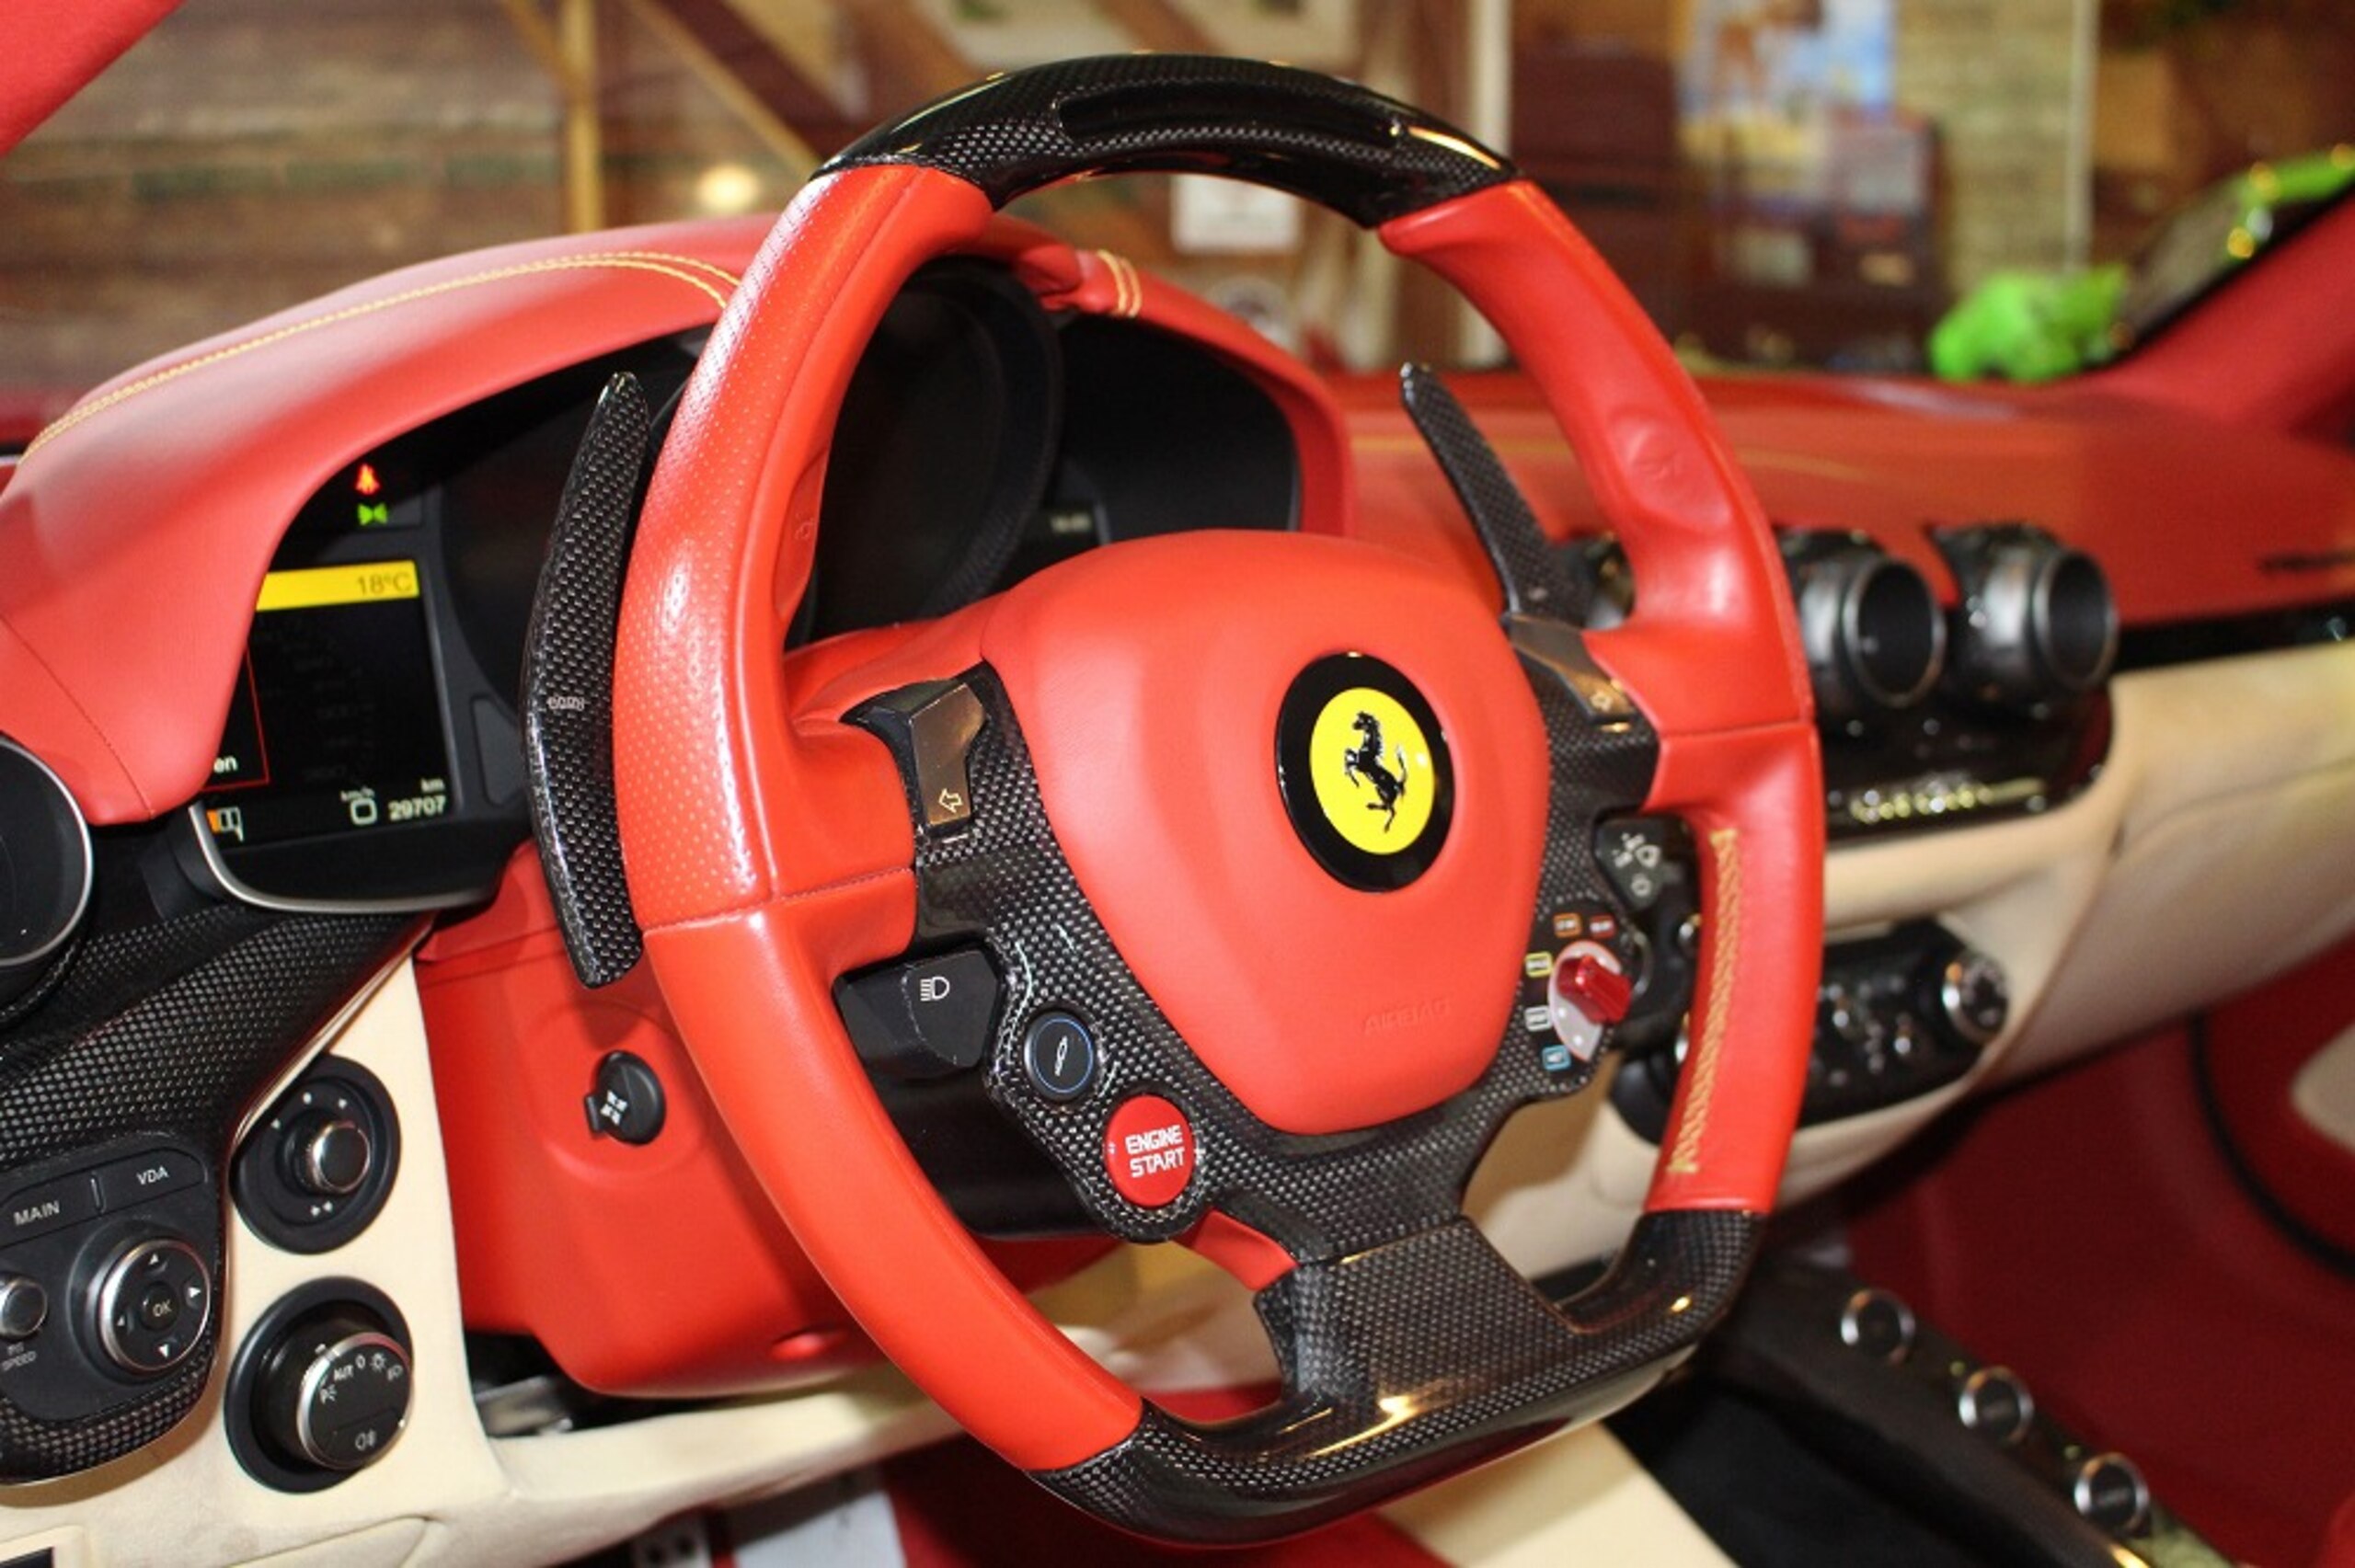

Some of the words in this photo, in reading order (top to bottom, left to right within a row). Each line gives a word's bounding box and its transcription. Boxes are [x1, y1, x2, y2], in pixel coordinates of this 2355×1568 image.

[387, 795, 447, 822] 29707
[1124, 1124, 1184, 1156] ENGINE
[136, 1165, 168, 1185] VDA
[1129, 1146, 1186, 1179] START
[13, 1199, 61, 1226] MAIN
[153, 1299, 173, 1317] OK
